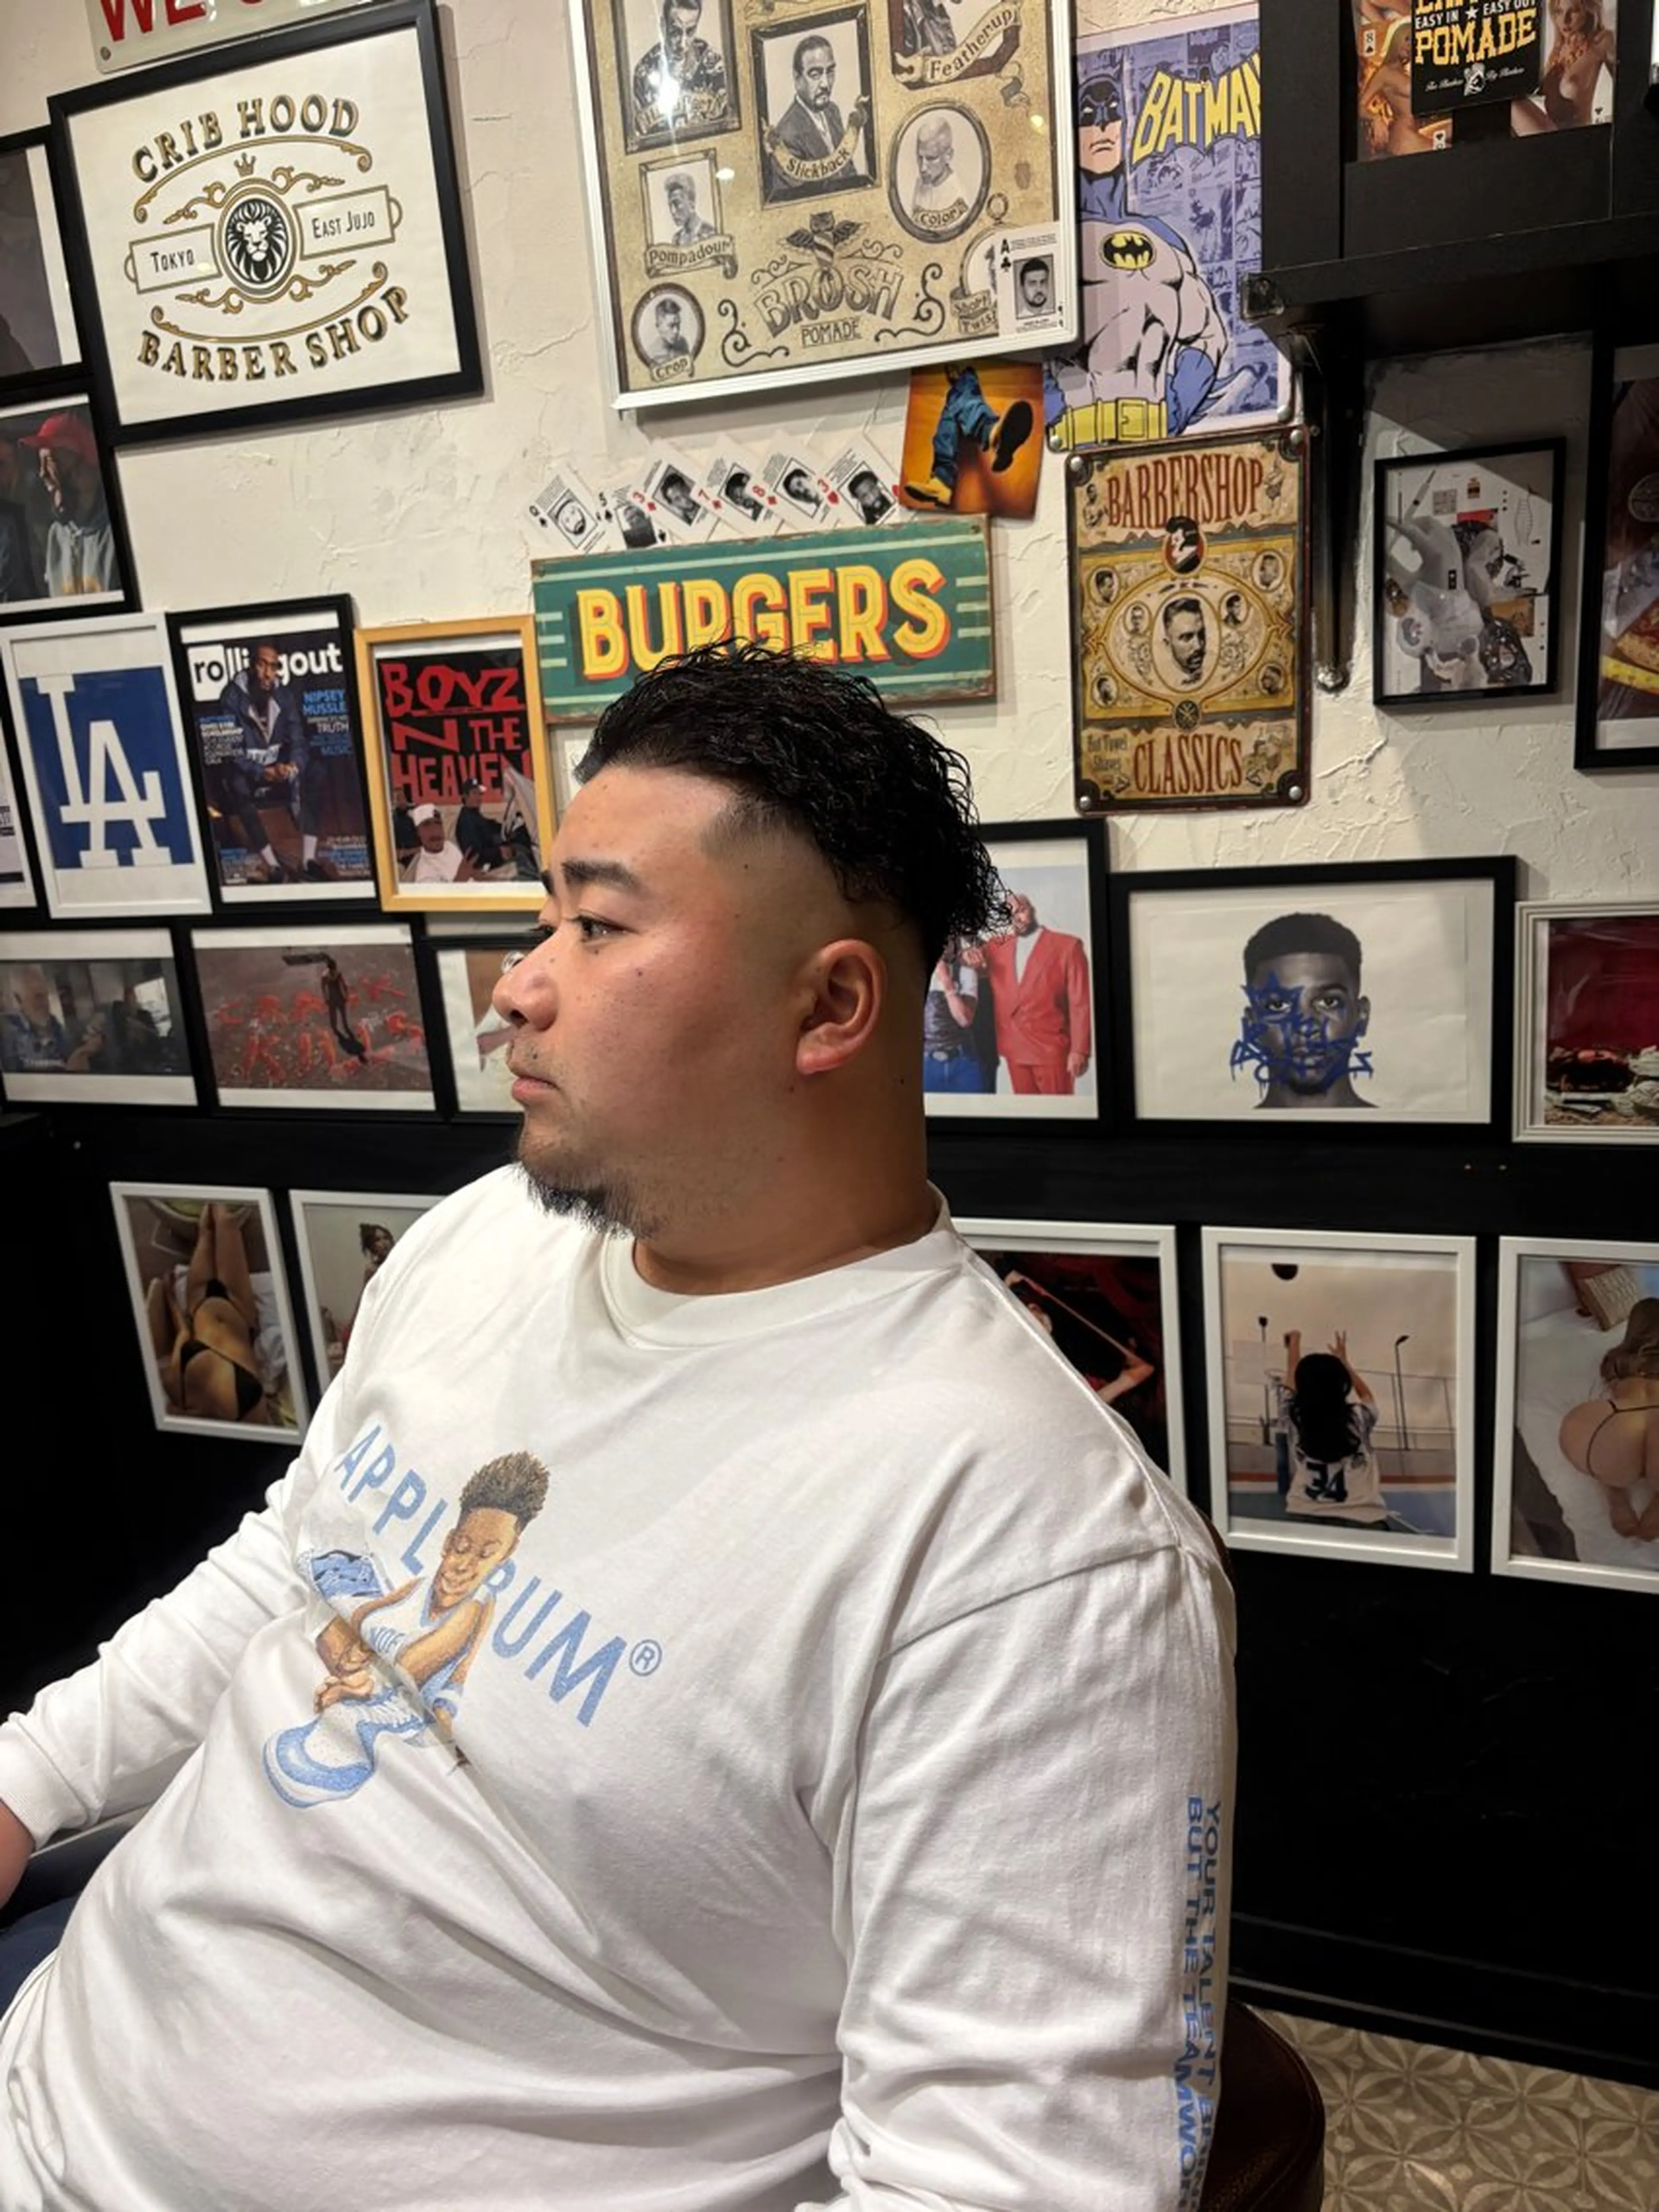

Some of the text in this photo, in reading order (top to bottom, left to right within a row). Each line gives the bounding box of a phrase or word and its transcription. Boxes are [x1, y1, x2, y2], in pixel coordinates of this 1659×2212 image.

[1415, 14, 1443, 30] EASY
[1446, 10, 1459, 23] IN
[1483, 0, 1511, 16] EASY
[1415, 8, 1537, 65] POMADE
[132, 94, 360, 181] CRIB HOOD
[786, 148, 850, 177] Slickback
[921, 209, 956, 224] Color
[1001, 239, 1010, 254] A
[754, 264, 904, 337] BROSH
[137, 284, 411, 382] BARBER SHOP
[802, 321, 860, 344] POMADE
[632, 492, 645, 503] 3
[698, 489, 710, 501] 7
[752, 485, 766, 497] 8
[1108, 453, 1264, 531] BARBERSHOP
[575, 559, 950, 681] BURGERS
[194, 643, 343, 686] rolligout
[381, 662, 525, 718] BOYZ
[392, 718, 521, 752] N THE
[37, 674, 172, 868] LA
[1134, 734, 1242, 795] CLASSICS
[1305, 1462, 1348, 1503] 34
[335, 1424, 627, 1726] APPLBUM
[1187, 1796, 1202, 1879] BUT
[1201, 1800, 1220, 1916] YOUR
[1184, 1895, 1200, 1974] THE
